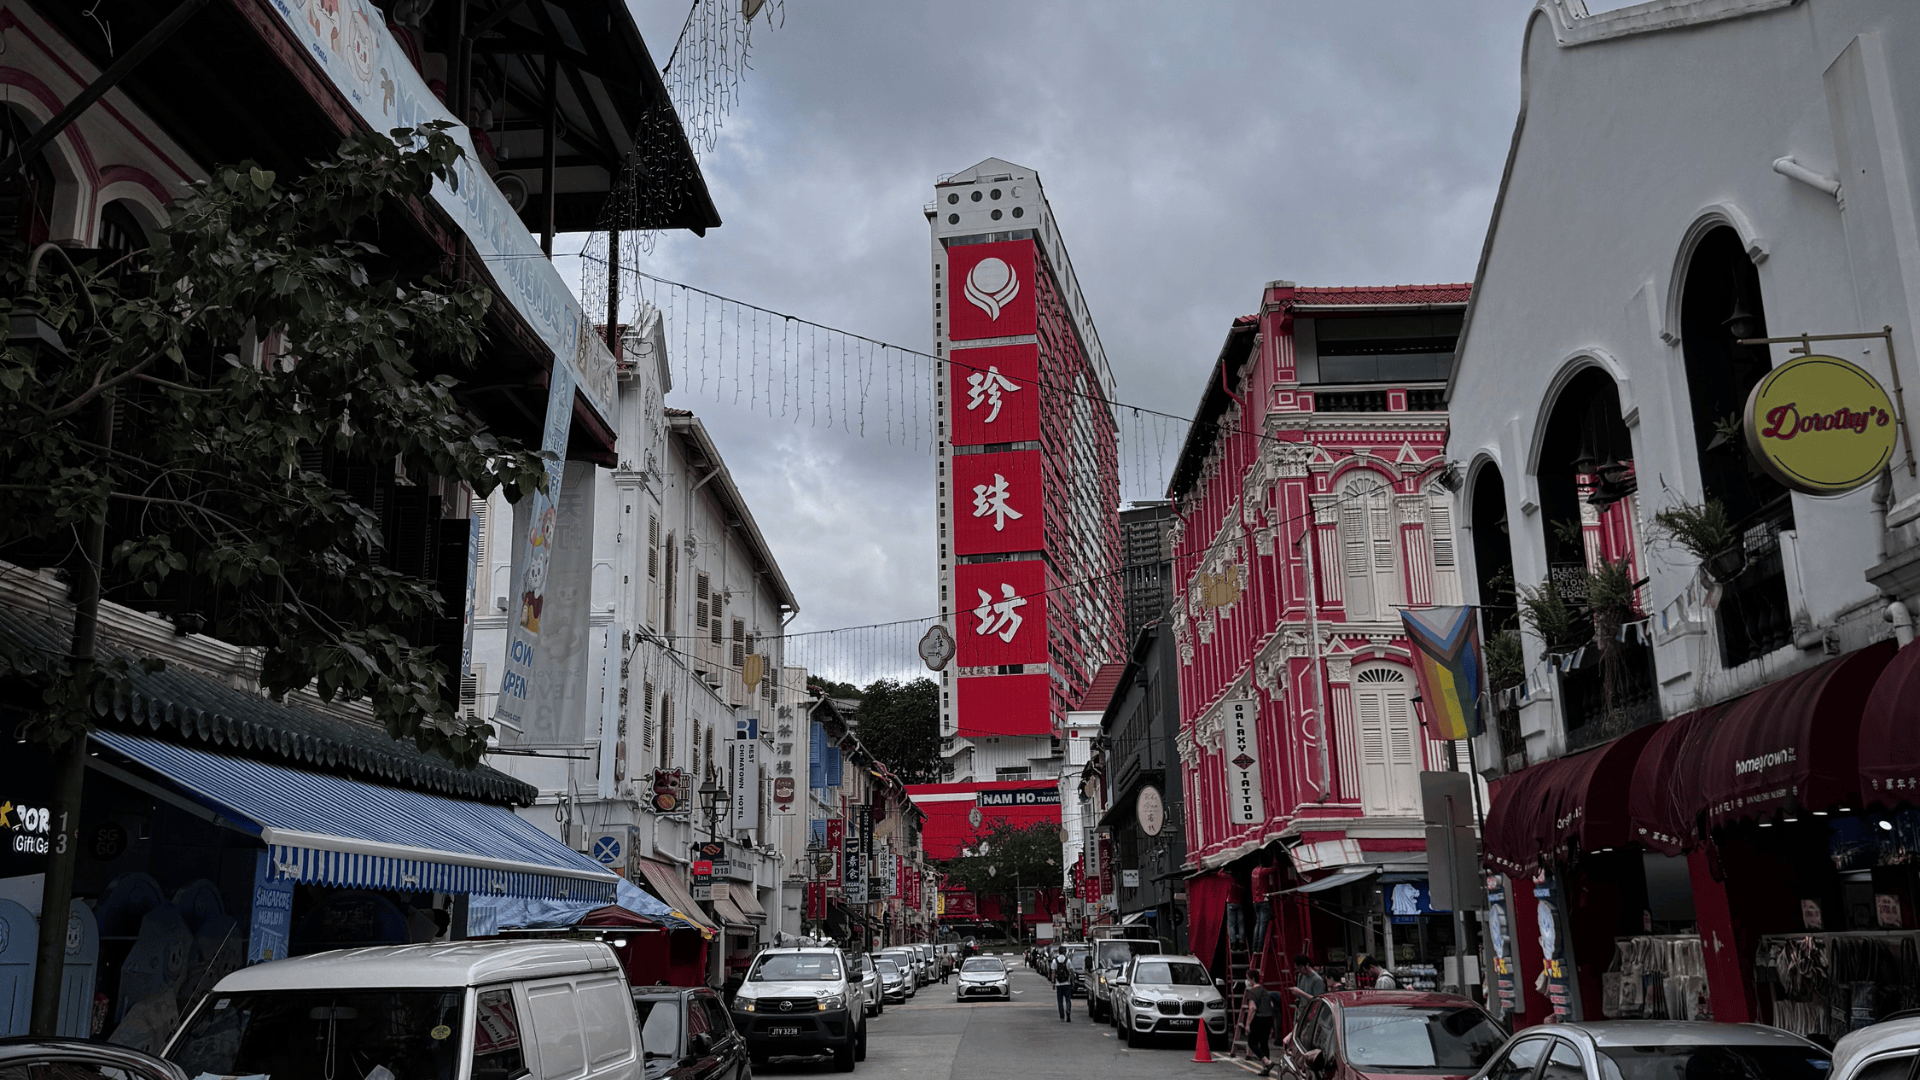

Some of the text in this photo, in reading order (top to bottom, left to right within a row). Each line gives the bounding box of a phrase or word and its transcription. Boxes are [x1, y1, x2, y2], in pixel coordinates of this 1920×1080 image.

[1761, 402, 1890, 440] Dorothy's
[966, 365, 1027, 643] 珍珠坊
[503, 669, 528, 700] OPEN
[1234, 704, 1253, 820] GALAXY TATTOO
[1735, 748, 1788, 777] homegrown
[983, 792, 1013, 805] NAM
[1016, 792, 1036, 803] HO
[771, 1027, 783, 1035] JTV
